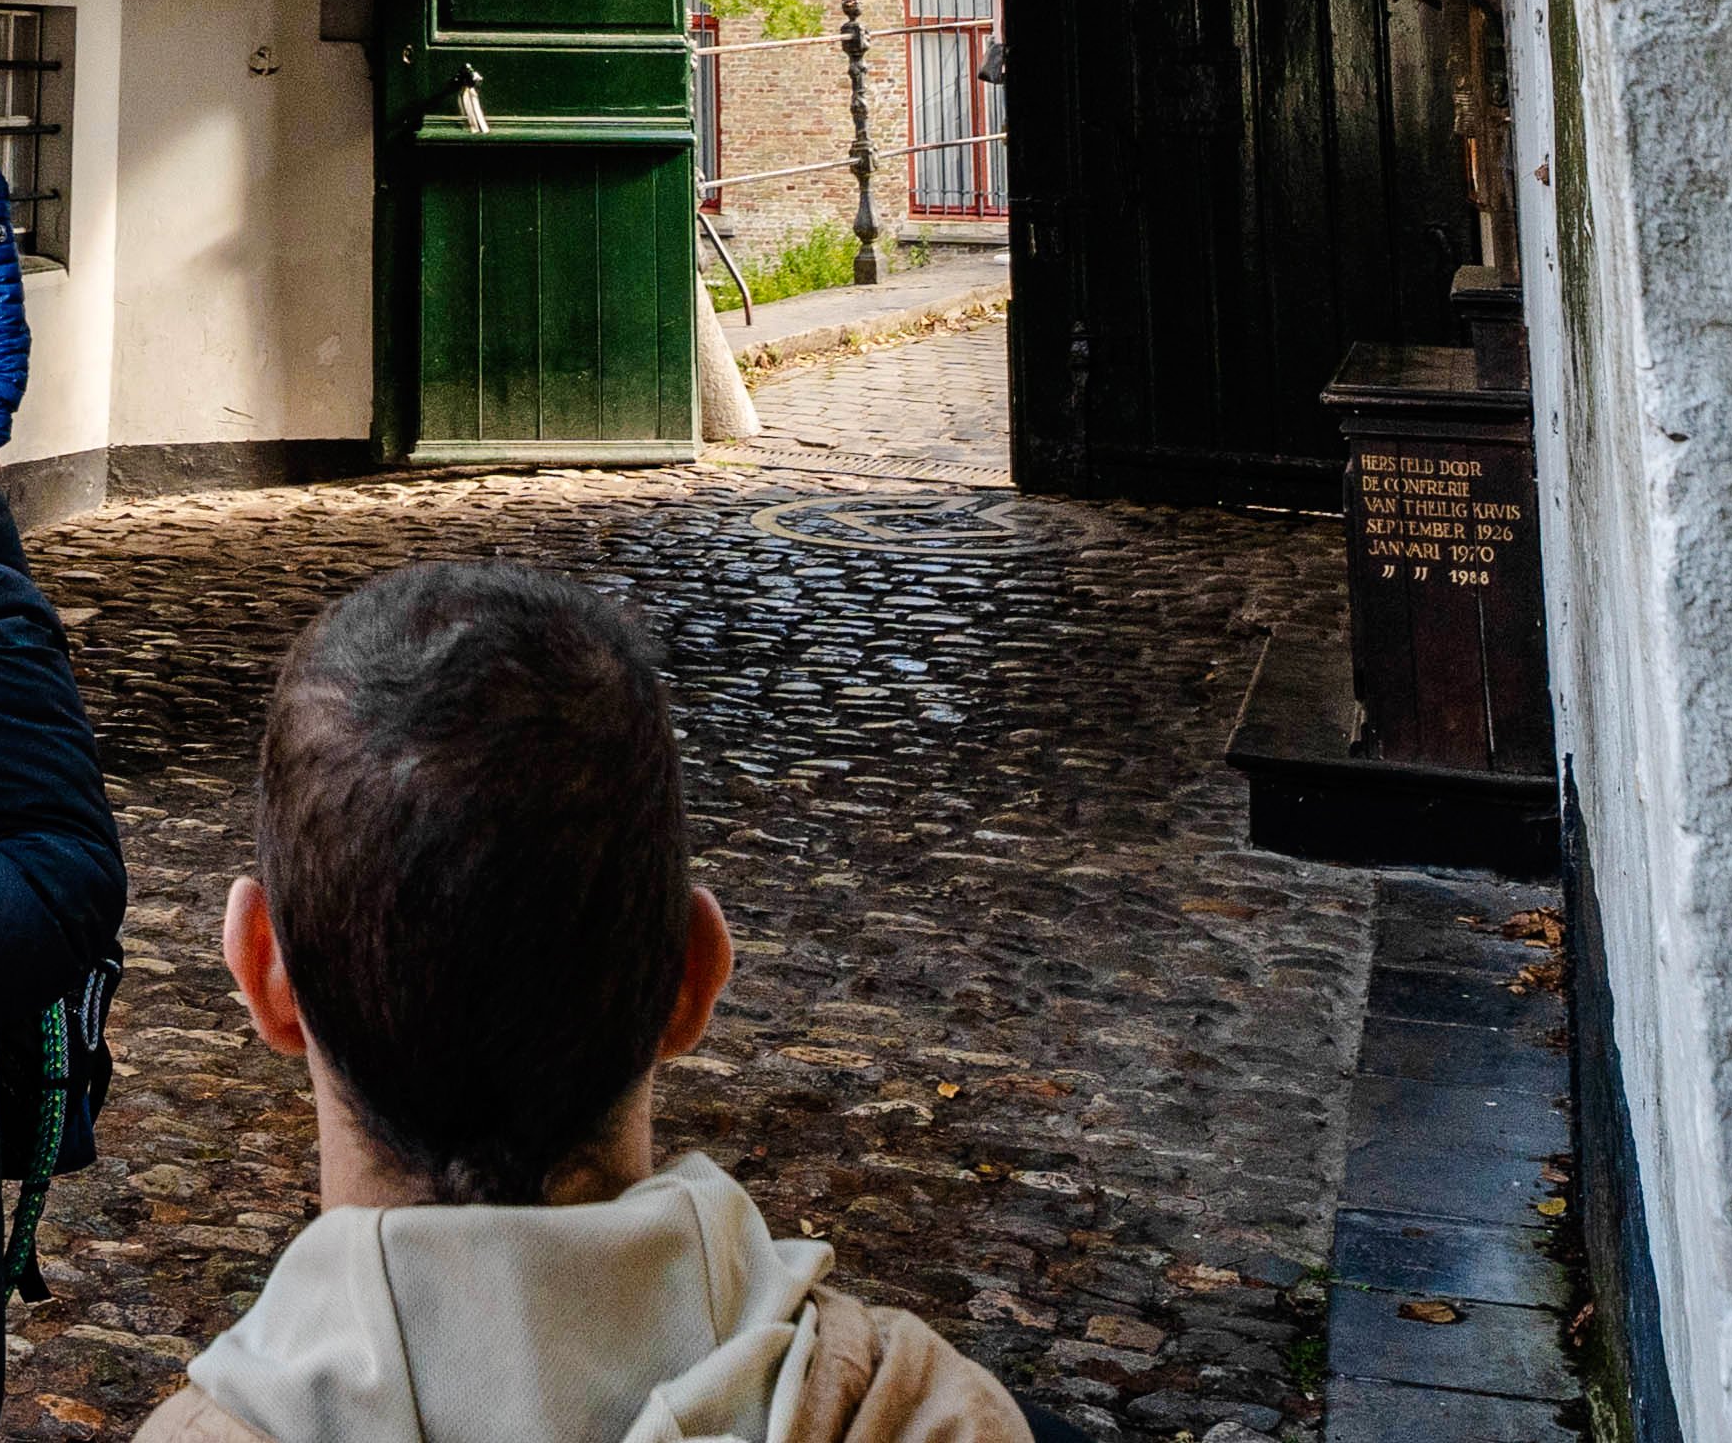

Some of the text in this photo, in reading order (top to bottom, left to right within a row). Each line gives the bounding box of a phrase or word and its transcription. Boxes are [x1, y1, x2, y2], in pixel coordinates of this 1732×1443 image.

[1361, 454, 1483, 477] HERSTELD DOOR
[1362, 475, 1471, 497] DE CONFRERIE
[1364, 497, 1396, 513] VAN
[1366, 518, 1514, 541] SEPTEMBER 1926
[1448, 545, 1495, 563] 1970
[1448, 570, 1490, 586] 1988
